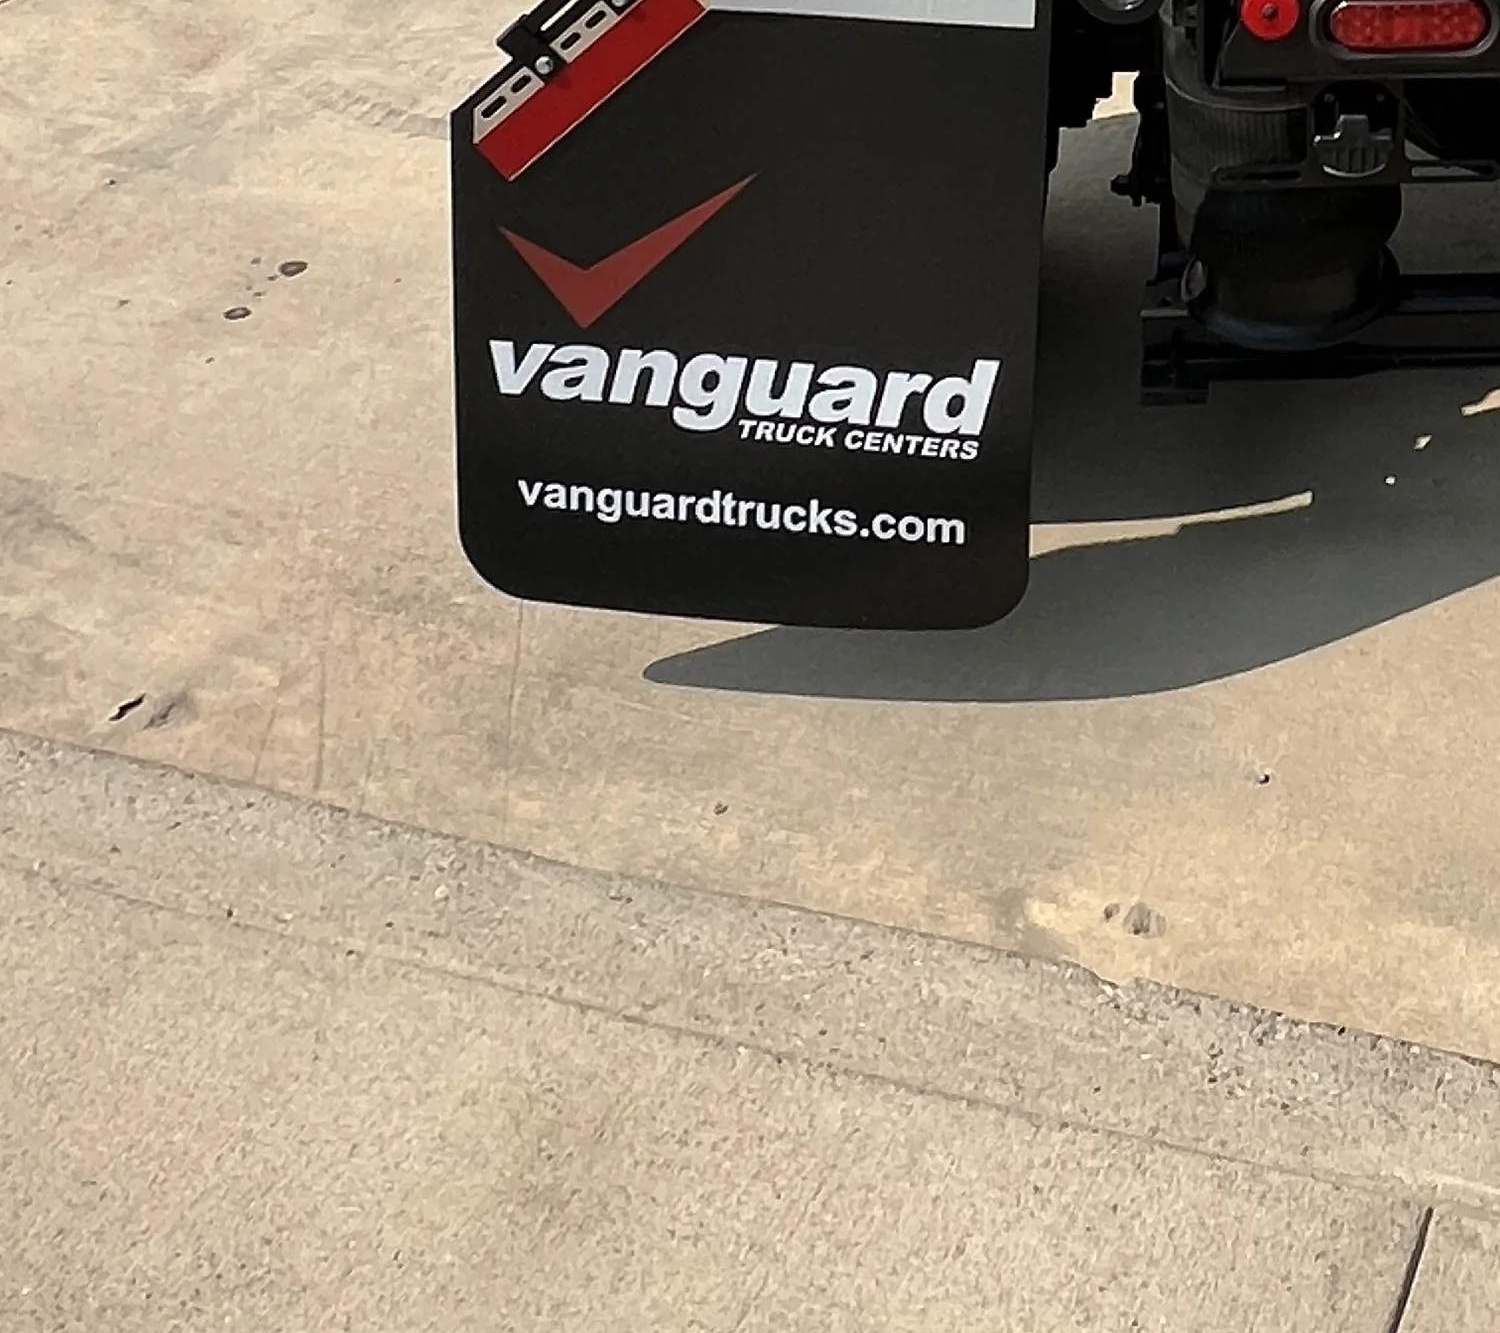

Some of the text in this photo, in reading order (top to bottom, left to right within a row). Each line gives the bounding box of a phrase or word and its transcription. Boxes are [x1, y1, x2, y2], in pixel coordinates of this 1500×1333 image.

[489, 339, 1001, 436] vanguard
[738, 419, 980, 460] TRUCK CENTERS
[518, 479, 965, 545] vanguardtrucks.com
